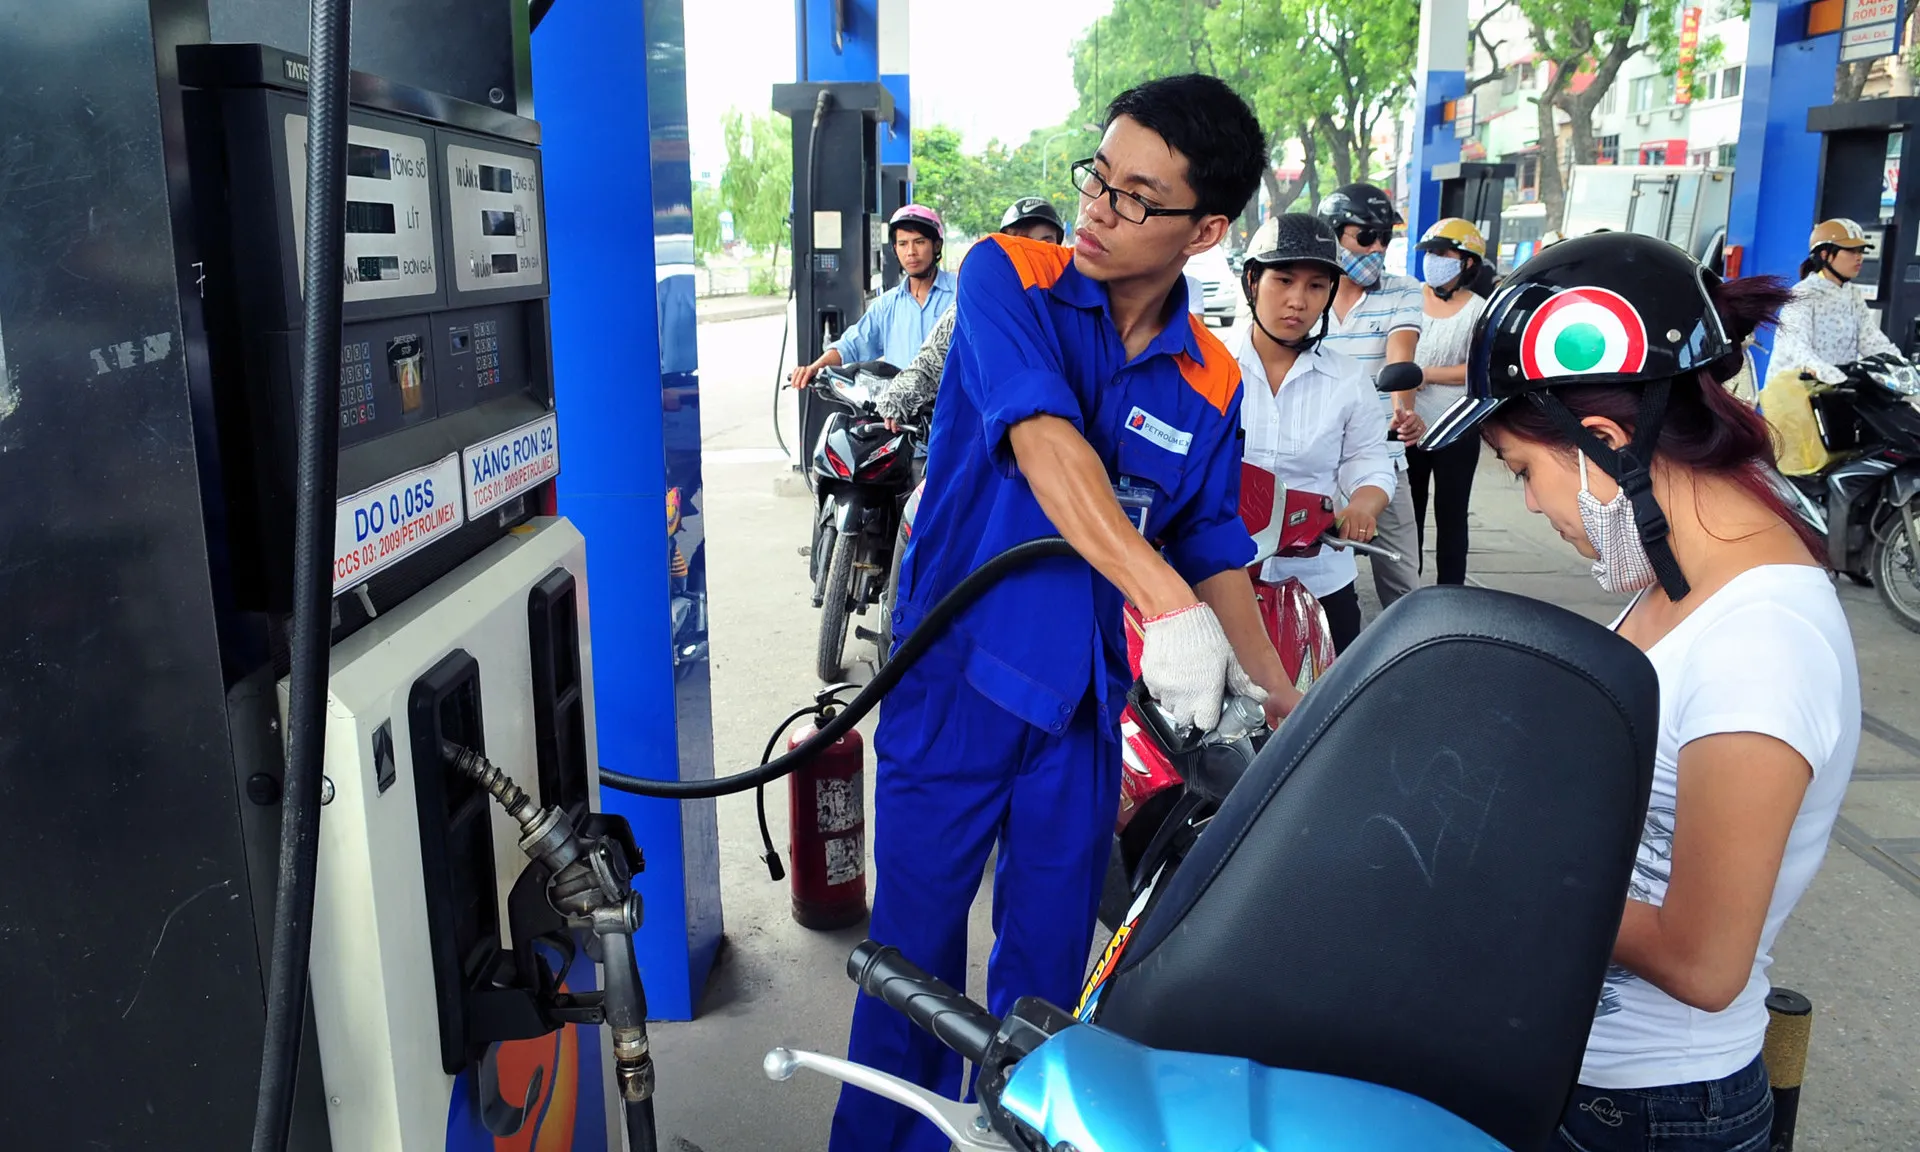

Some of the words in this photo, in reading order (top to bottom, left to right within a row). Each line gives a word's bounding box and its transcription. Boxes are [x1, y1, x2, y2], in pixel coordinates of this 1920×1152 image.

[1852, 7, 1877, 20] RON
[1880, 3, 1894, 15] 92
[406, 206, 420, 230] LÍT
[403, 259, 420, 275] ĐƠN
[420, 255, 433, 275] GIÁ
[1144, 423, 1190, 447] PETROLIMEX
[472, 444, 511, 486] XĂNG
[513, 432, 539, 467] RON
[540, 426, 553, 453] 92
[473, 483, 493, 509] TCCS
[504, 453, 555, 493] 2009/PETROLIMEX
[354, 500, 385, 542] DO
[389, 478, 435, 526] 0,05S
[362, 543, 378, 567] 03:
[379, 502, 457, 557] 2009/PETROLIMEX
